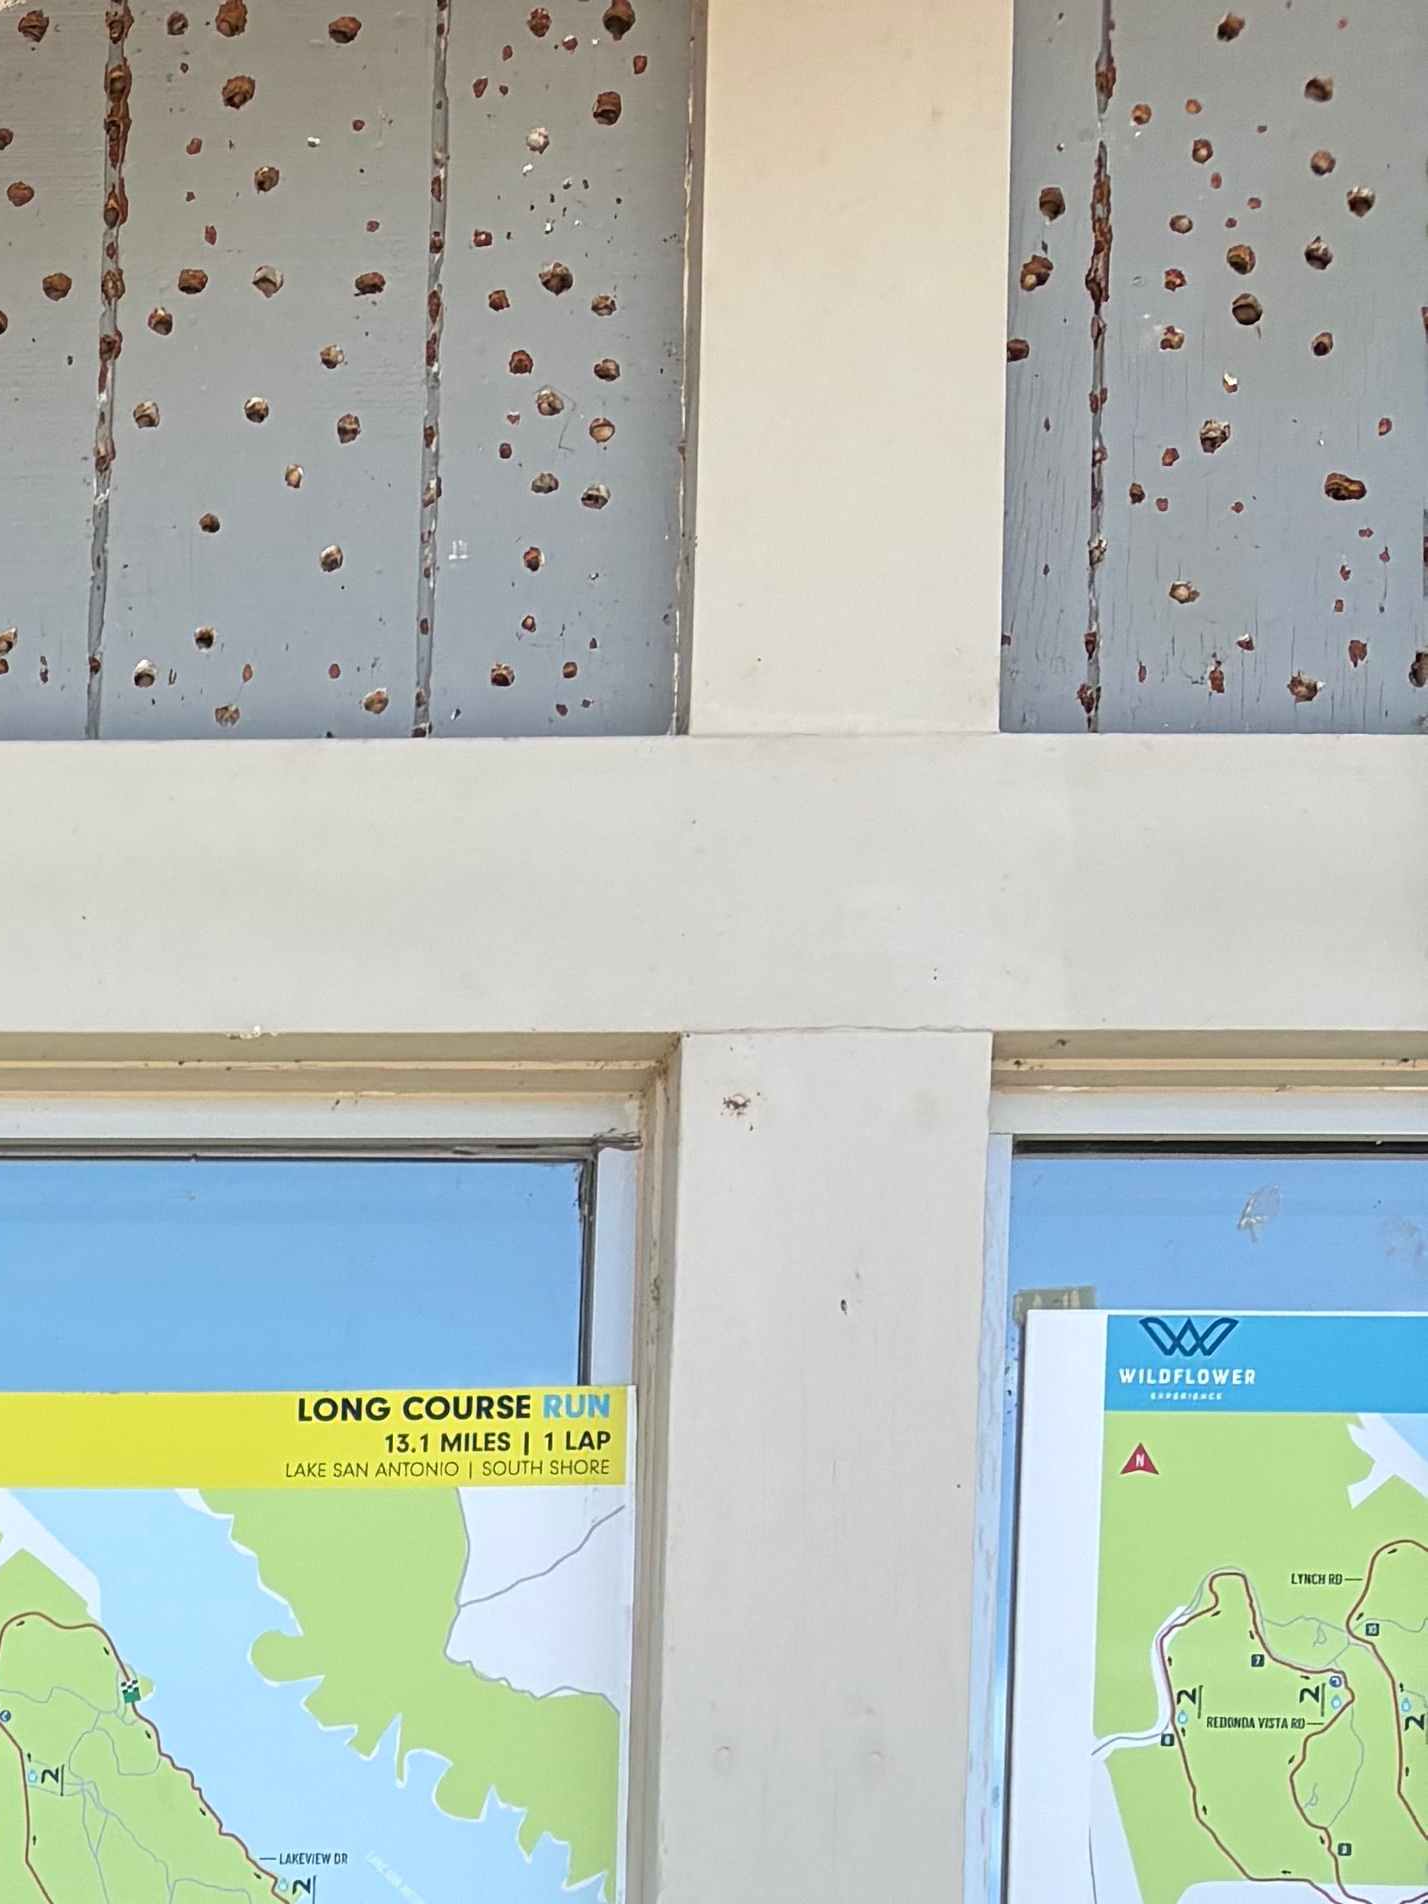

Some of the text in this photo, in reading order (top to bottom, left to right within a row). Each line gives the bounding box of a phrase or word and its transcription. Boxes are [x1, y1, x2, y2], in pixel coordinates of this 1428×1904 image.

[1119, 1369, 1255, 1384] WILDFLOWER
[299, 1395, 610, 1421] LONG COURSE RUN
[386, 1431, 610, 1453] 13.1 MILES 1 LAP
[286, 1459, 609, 1477] LAKE SAN ANTONIO SOUTH SHORE
